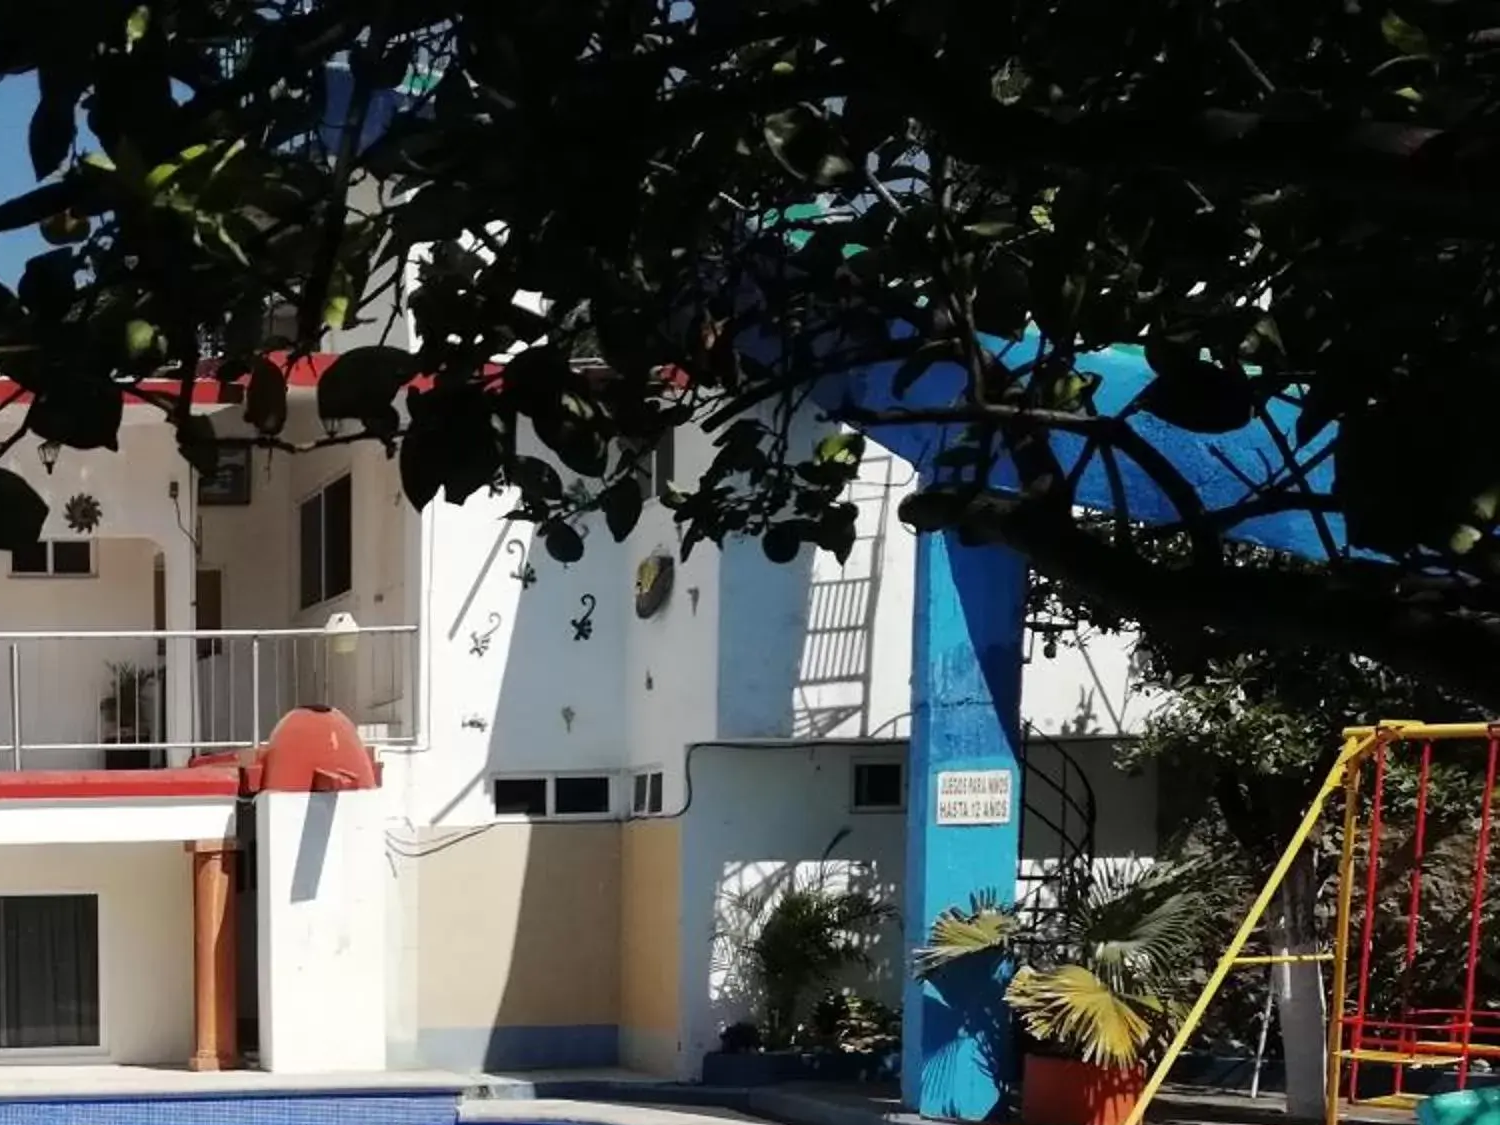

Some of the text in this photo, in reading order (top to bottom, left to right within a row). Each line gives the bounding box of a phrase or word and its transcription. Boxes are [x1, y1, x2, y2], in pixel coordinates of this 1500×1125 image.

[968, 776, 987, 794] PARA
[940, 801, 968, 818] HASTA
[971, 801, 982, 818] 12
